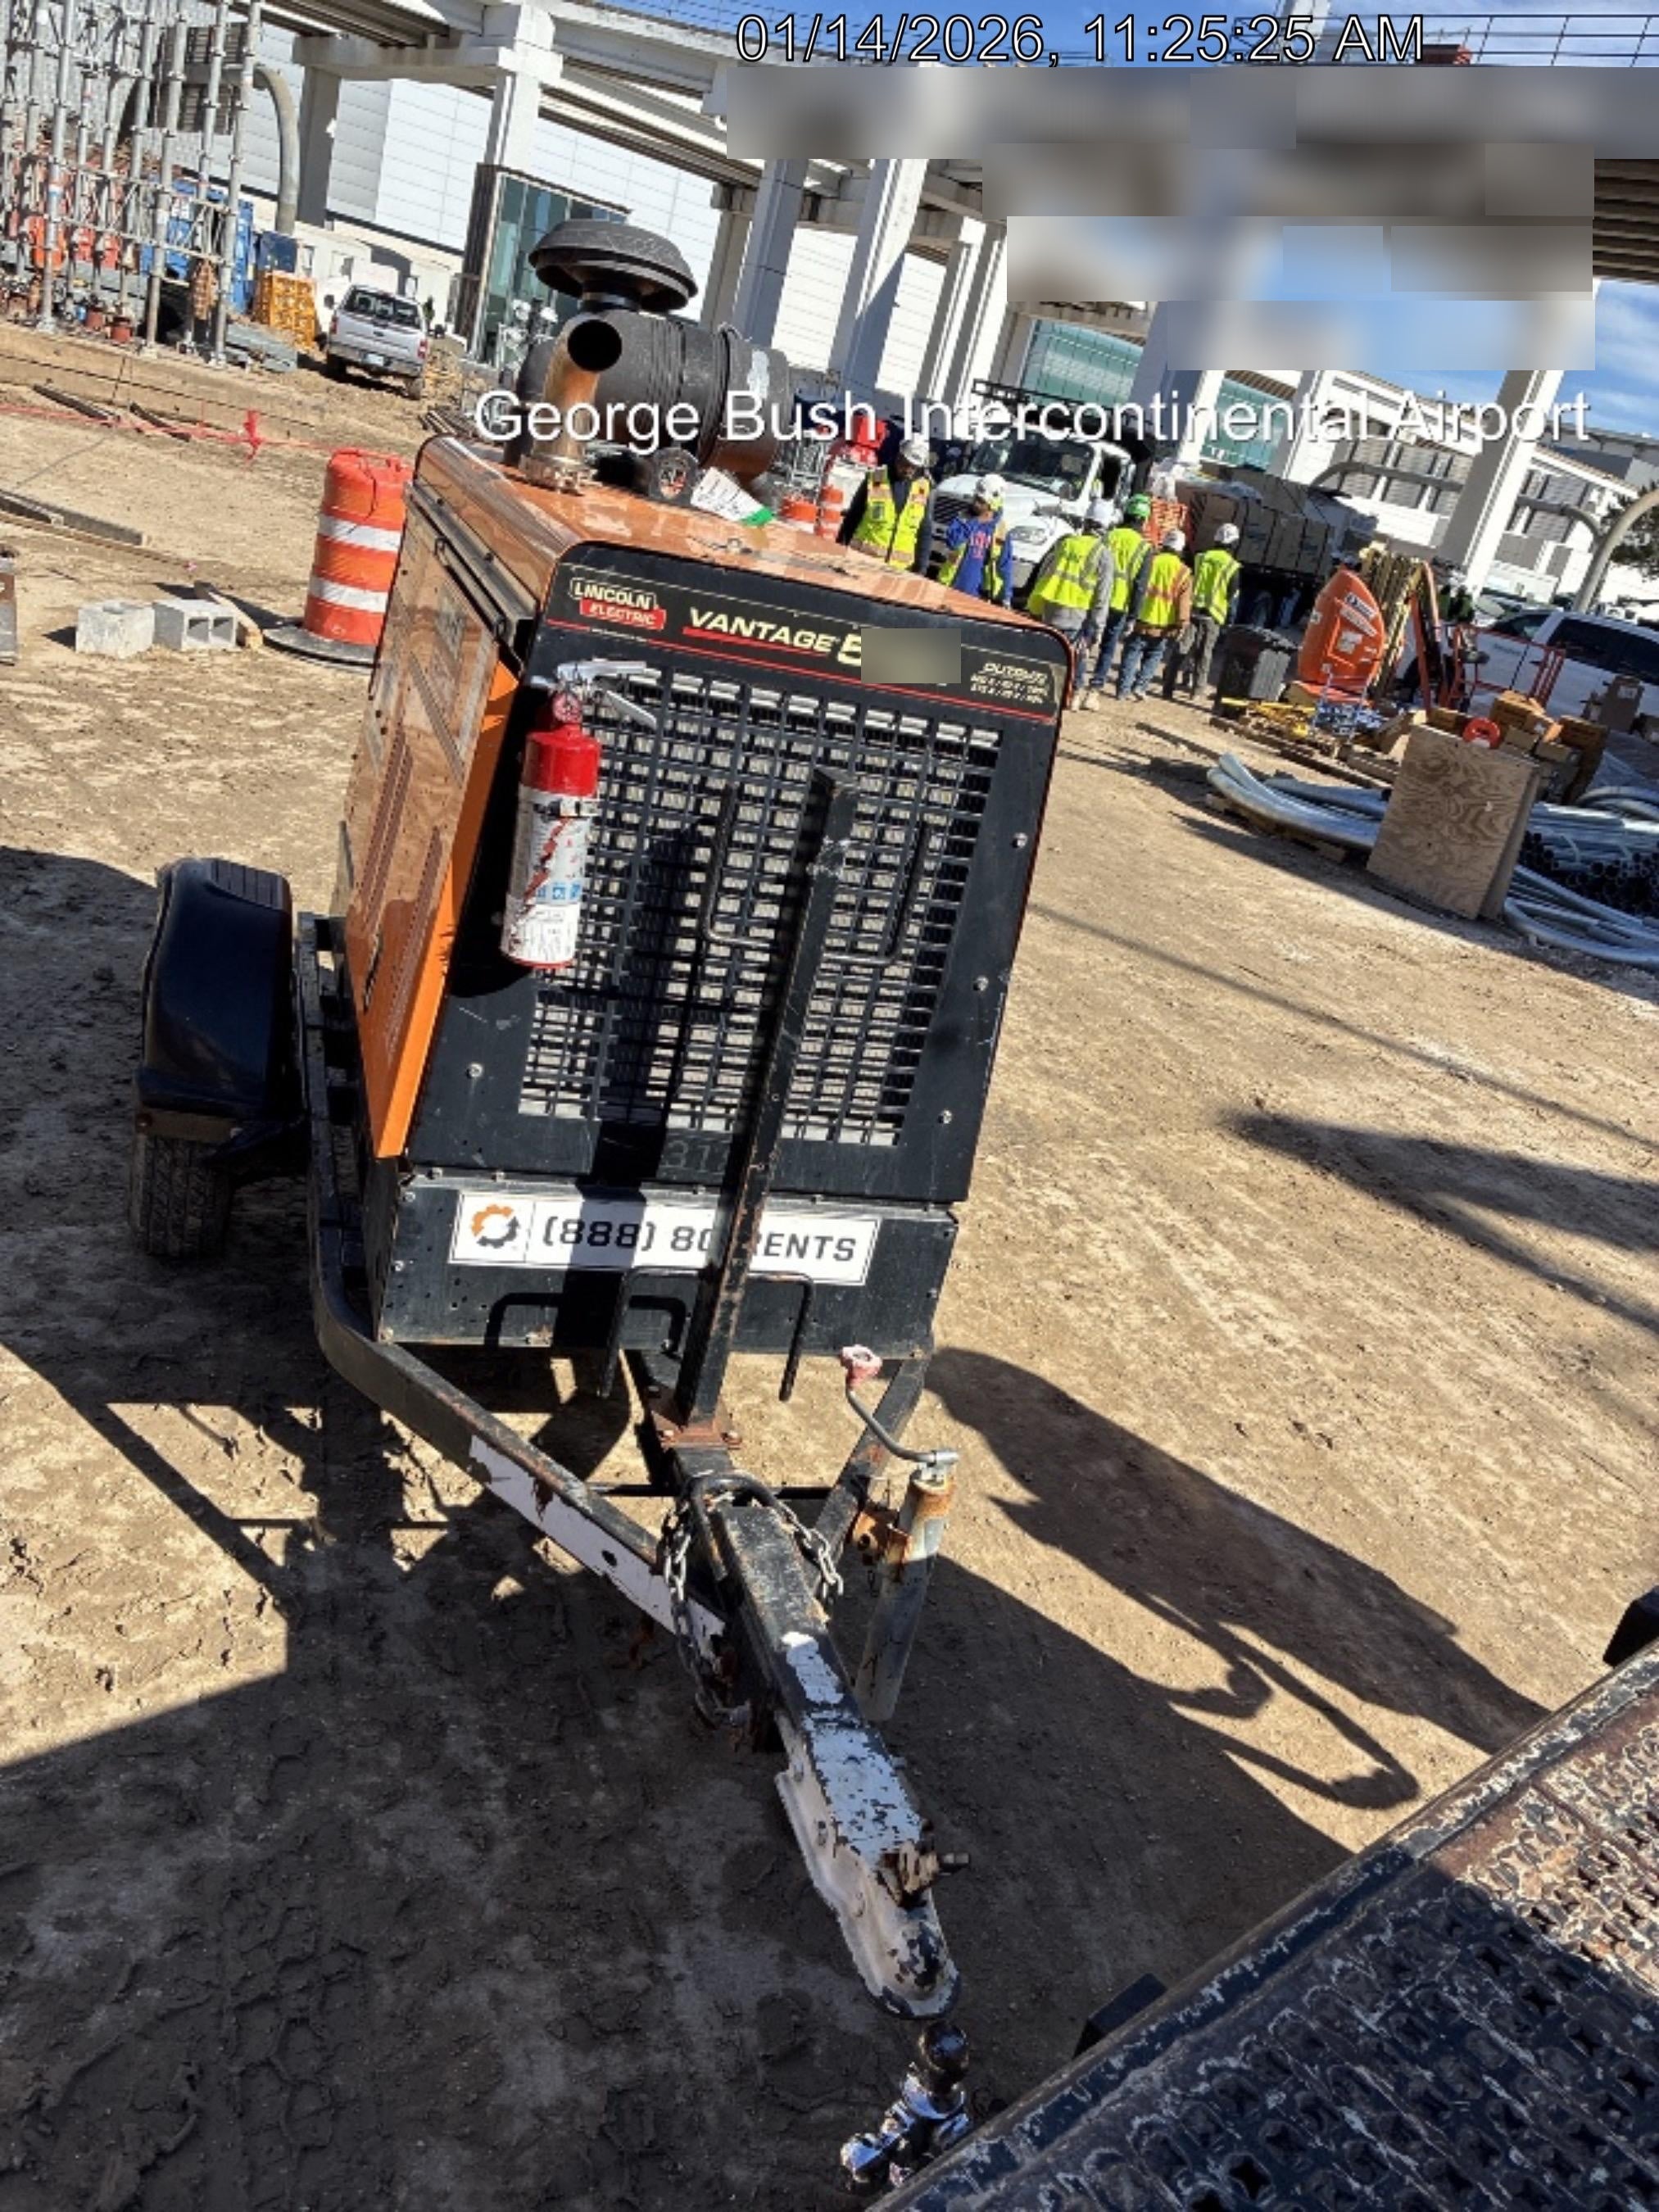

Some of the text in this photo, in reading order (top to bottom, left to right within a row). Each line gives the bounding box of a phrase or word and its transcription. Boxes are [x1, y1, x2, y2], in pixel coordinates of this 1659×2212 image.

[573, 581, 652, 610] LINCOLN
[588, 602, 657, 626] ELECTRIC
[689, 606, 834, 654] VANTAGE
[542, 1215, 657, 1252] (888)
[752, 1231, 857, 1262] ENTS
